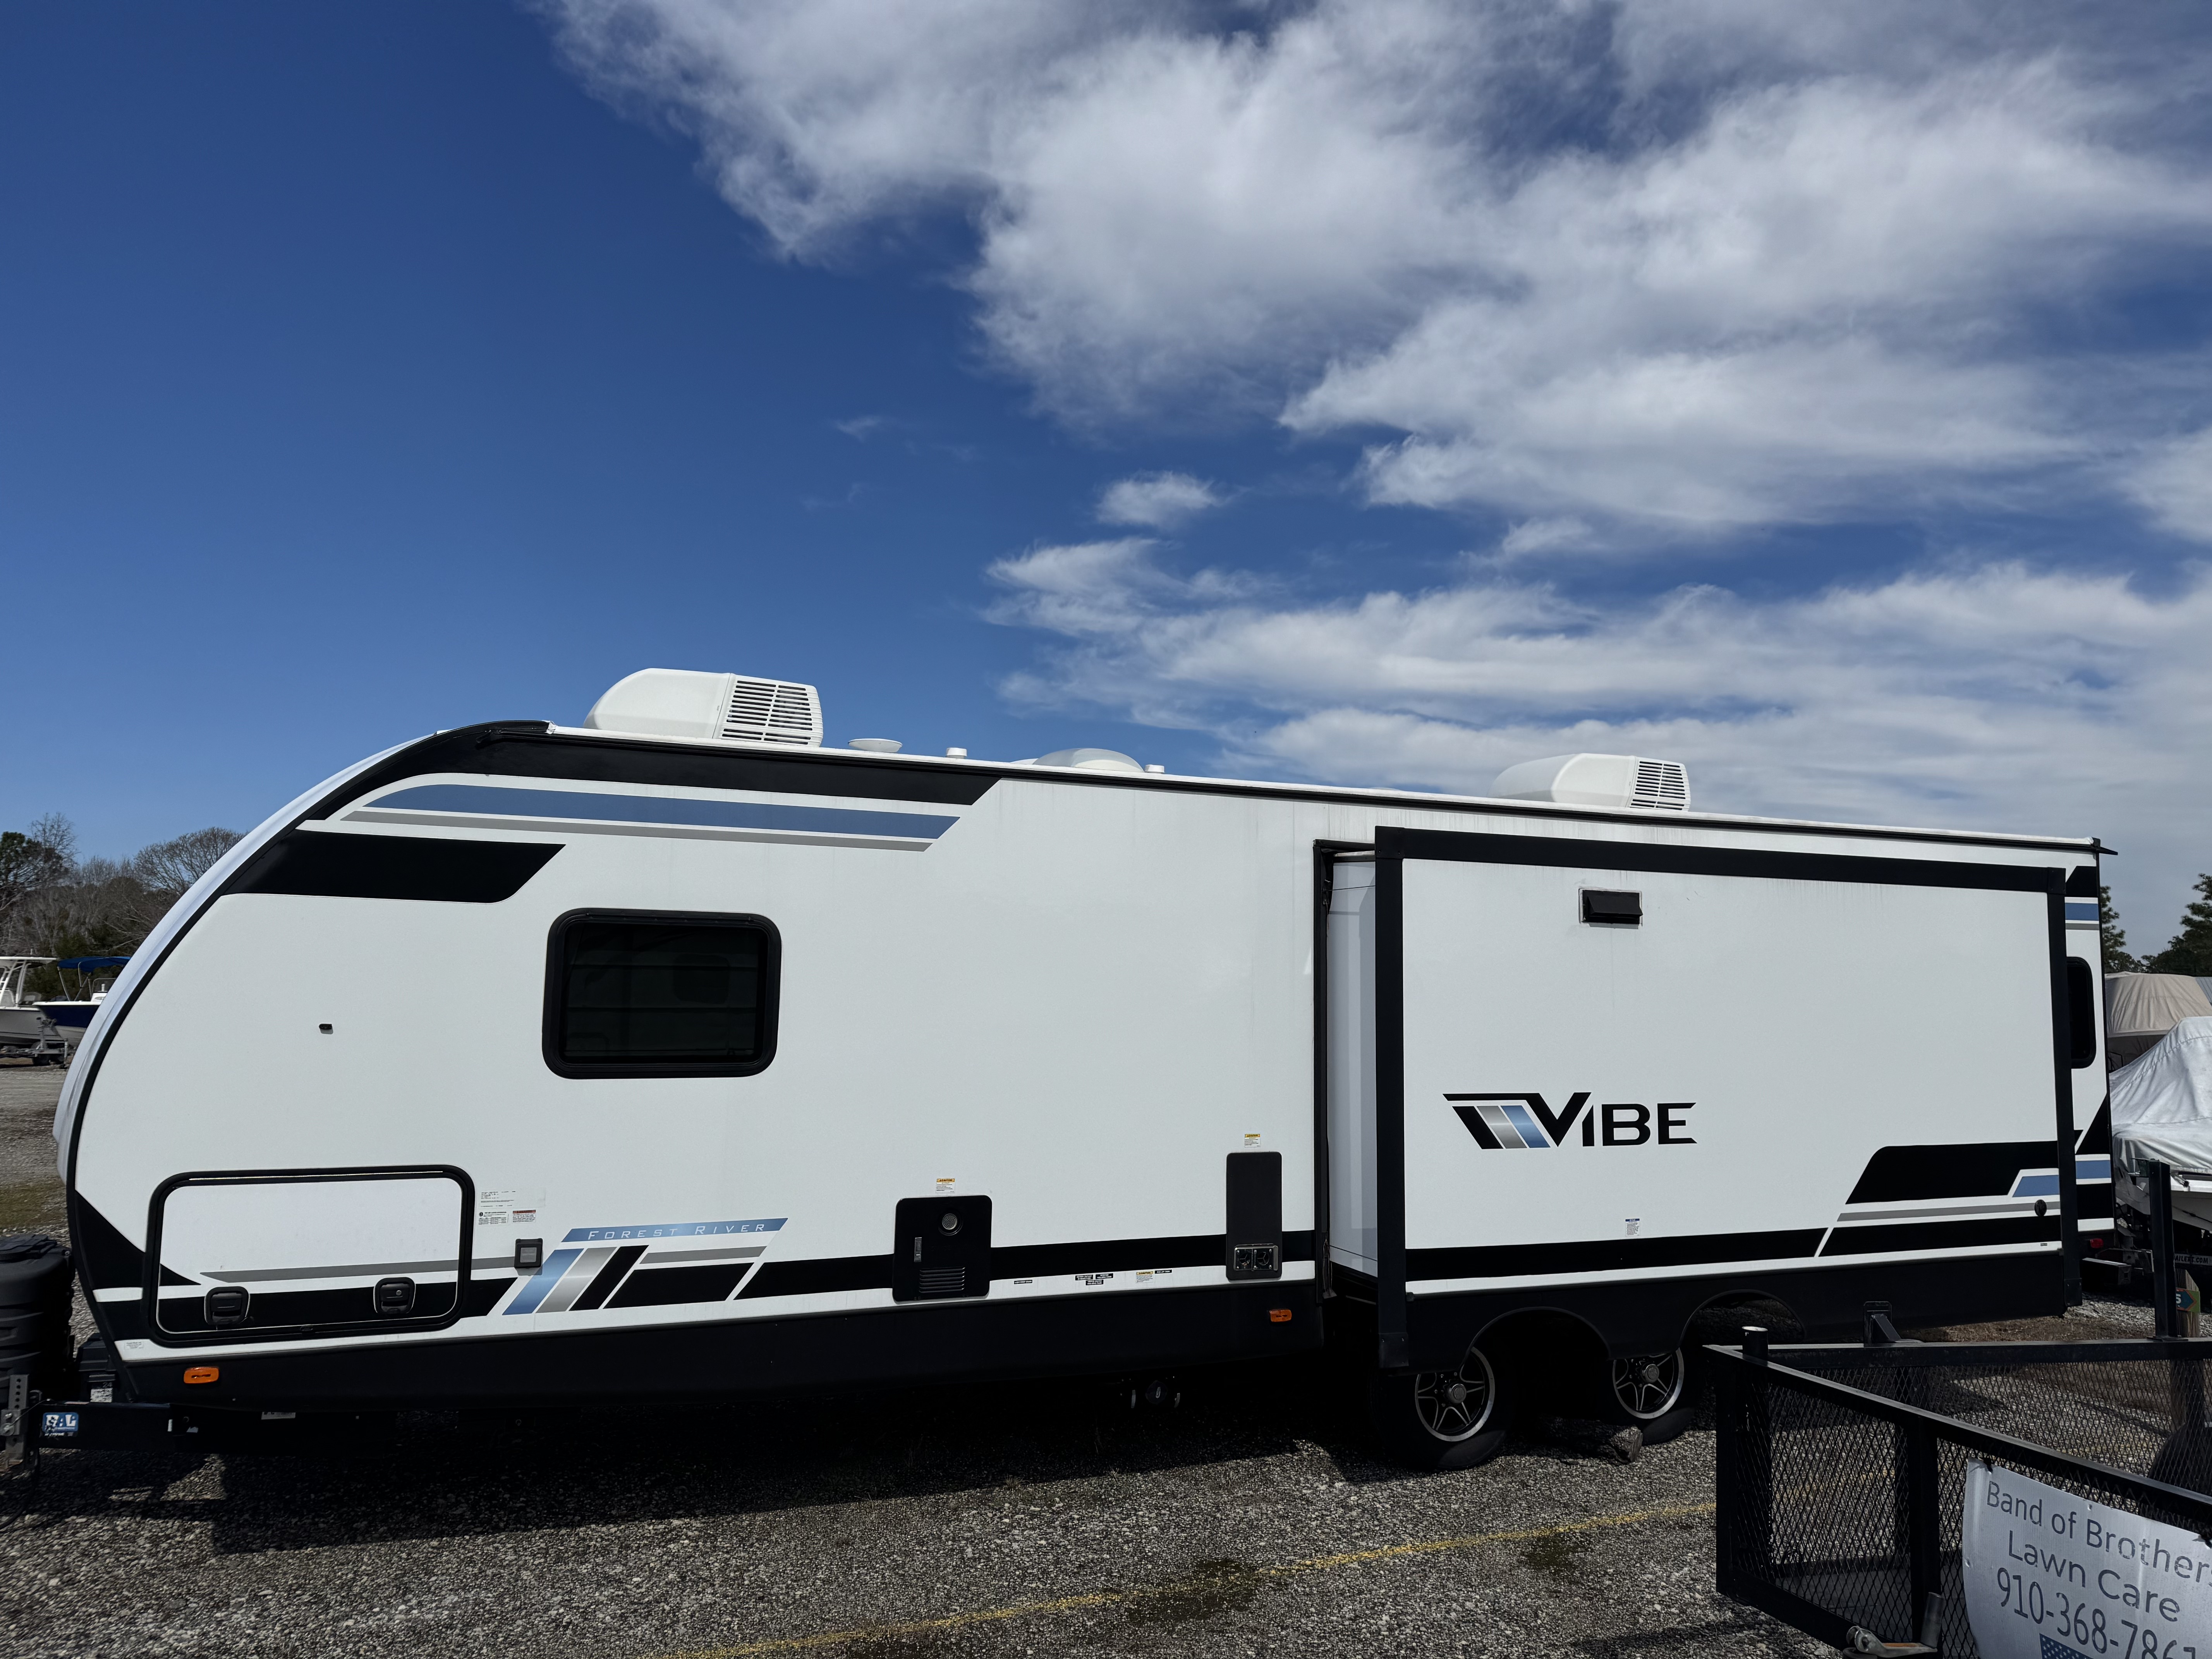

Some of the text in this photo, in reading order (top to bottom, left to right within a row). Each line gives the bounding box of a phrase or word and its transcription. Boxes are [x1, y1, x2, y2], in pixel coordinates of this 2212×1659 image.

[1443, 1092, 1697, 1147] VIBE
[587, 1224, 764, 1240] FOREST RIVER
[1987, 1480, 2212, 1587] Band of Brother
[2009, 1530, 2180, 1622] Lawn Care
[1997, 1567, 2196, 1659] 910-368-78
